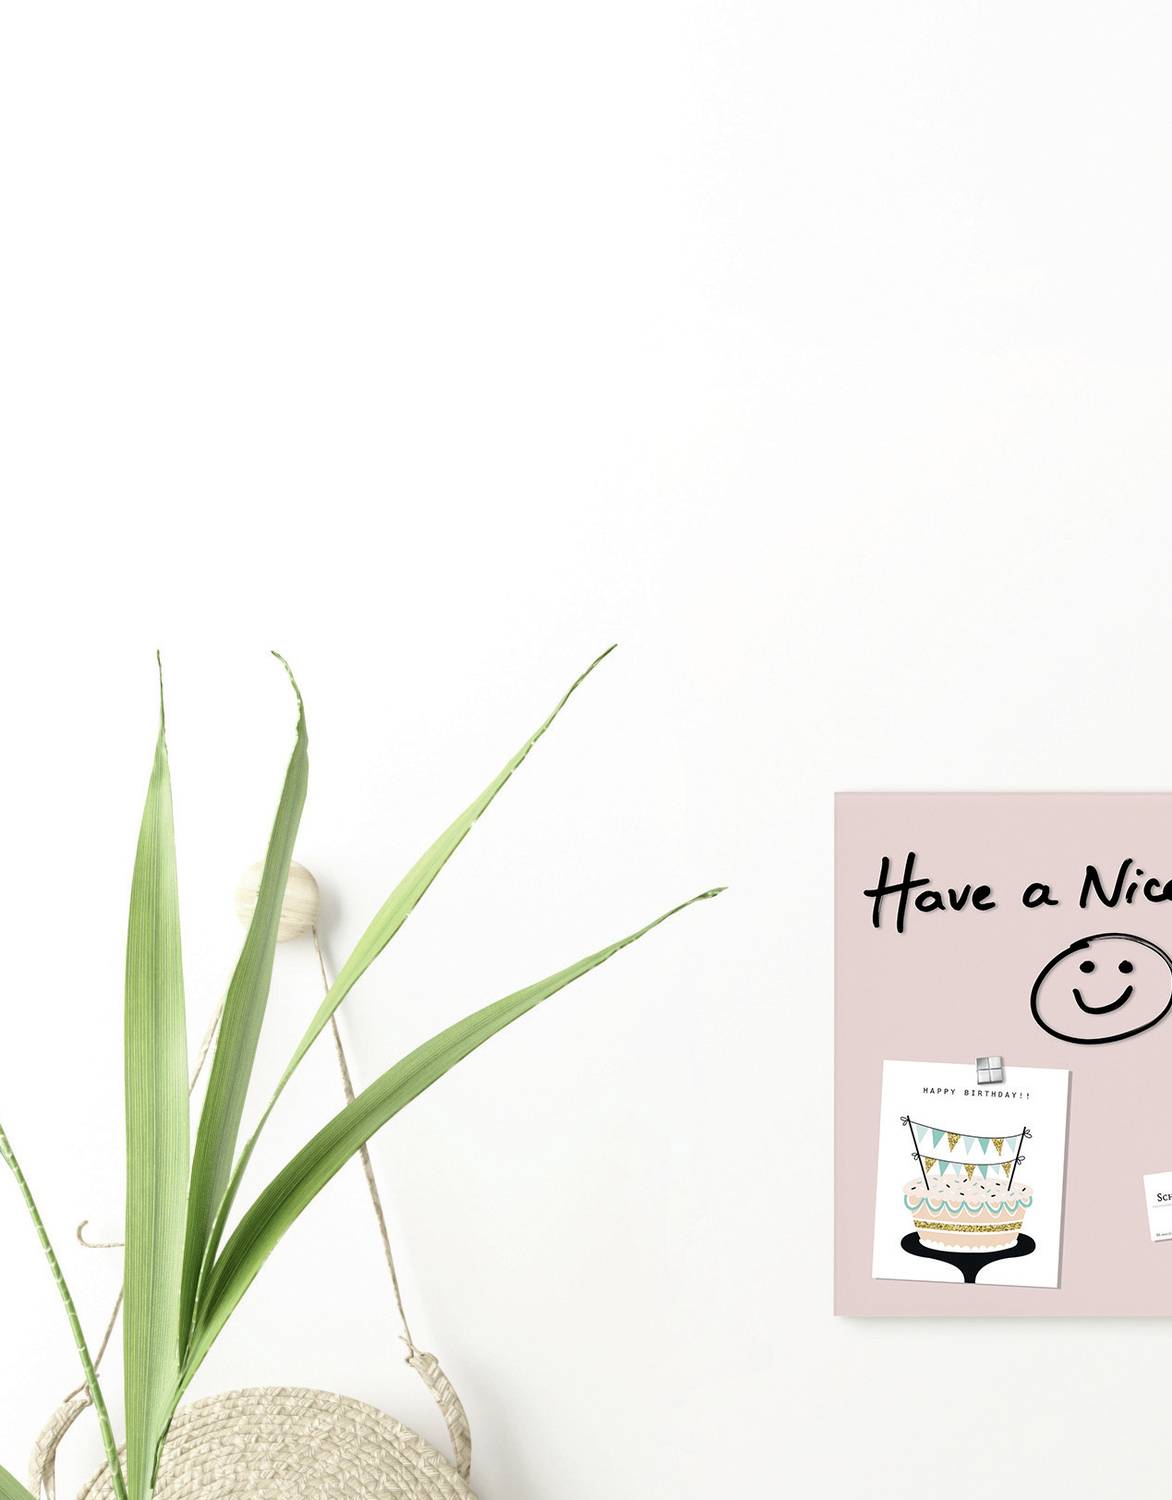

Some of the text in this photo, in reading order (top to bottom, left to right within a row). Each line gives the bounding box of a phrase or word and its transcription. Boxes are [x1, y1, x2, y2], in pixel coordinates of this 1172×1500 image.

[863, 851, 997, 934] Have
[1022, 882, 1059, 909] a
[922, 1087, 1030, 1100] HAPPY BIRTHDAY!!
